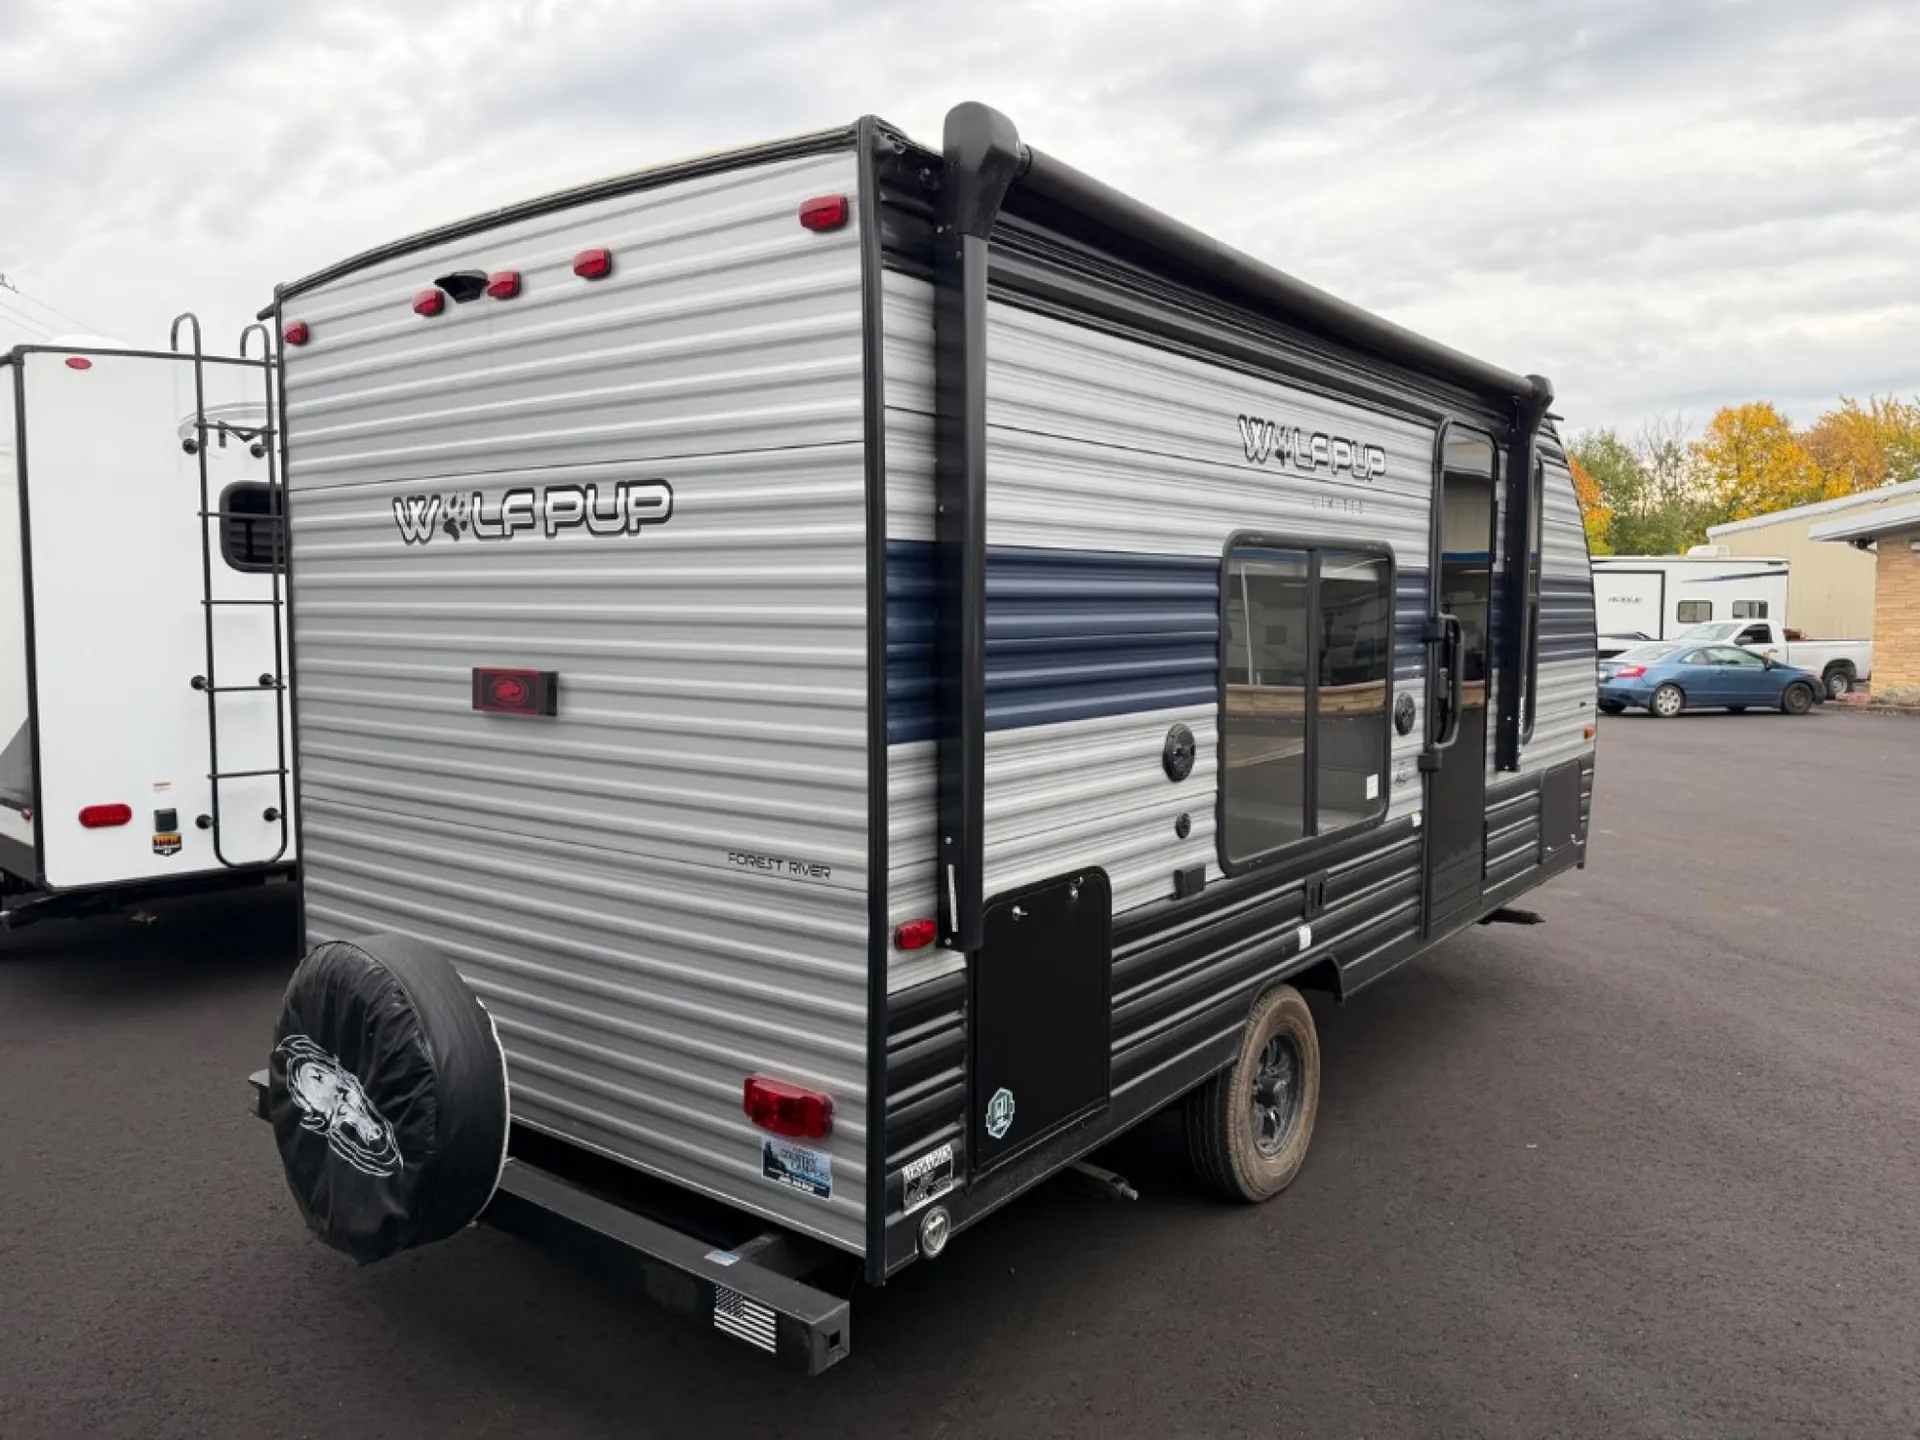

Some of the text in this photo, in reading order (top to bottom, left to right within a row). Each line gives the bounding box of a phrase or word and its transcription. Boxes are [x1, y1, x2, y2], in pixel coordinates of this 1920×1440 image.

[1332, 436, 1385, 481] PUP
[545, 479, 673, 538] PUP
[728, 852, 831, 879] FOREST RIVER
